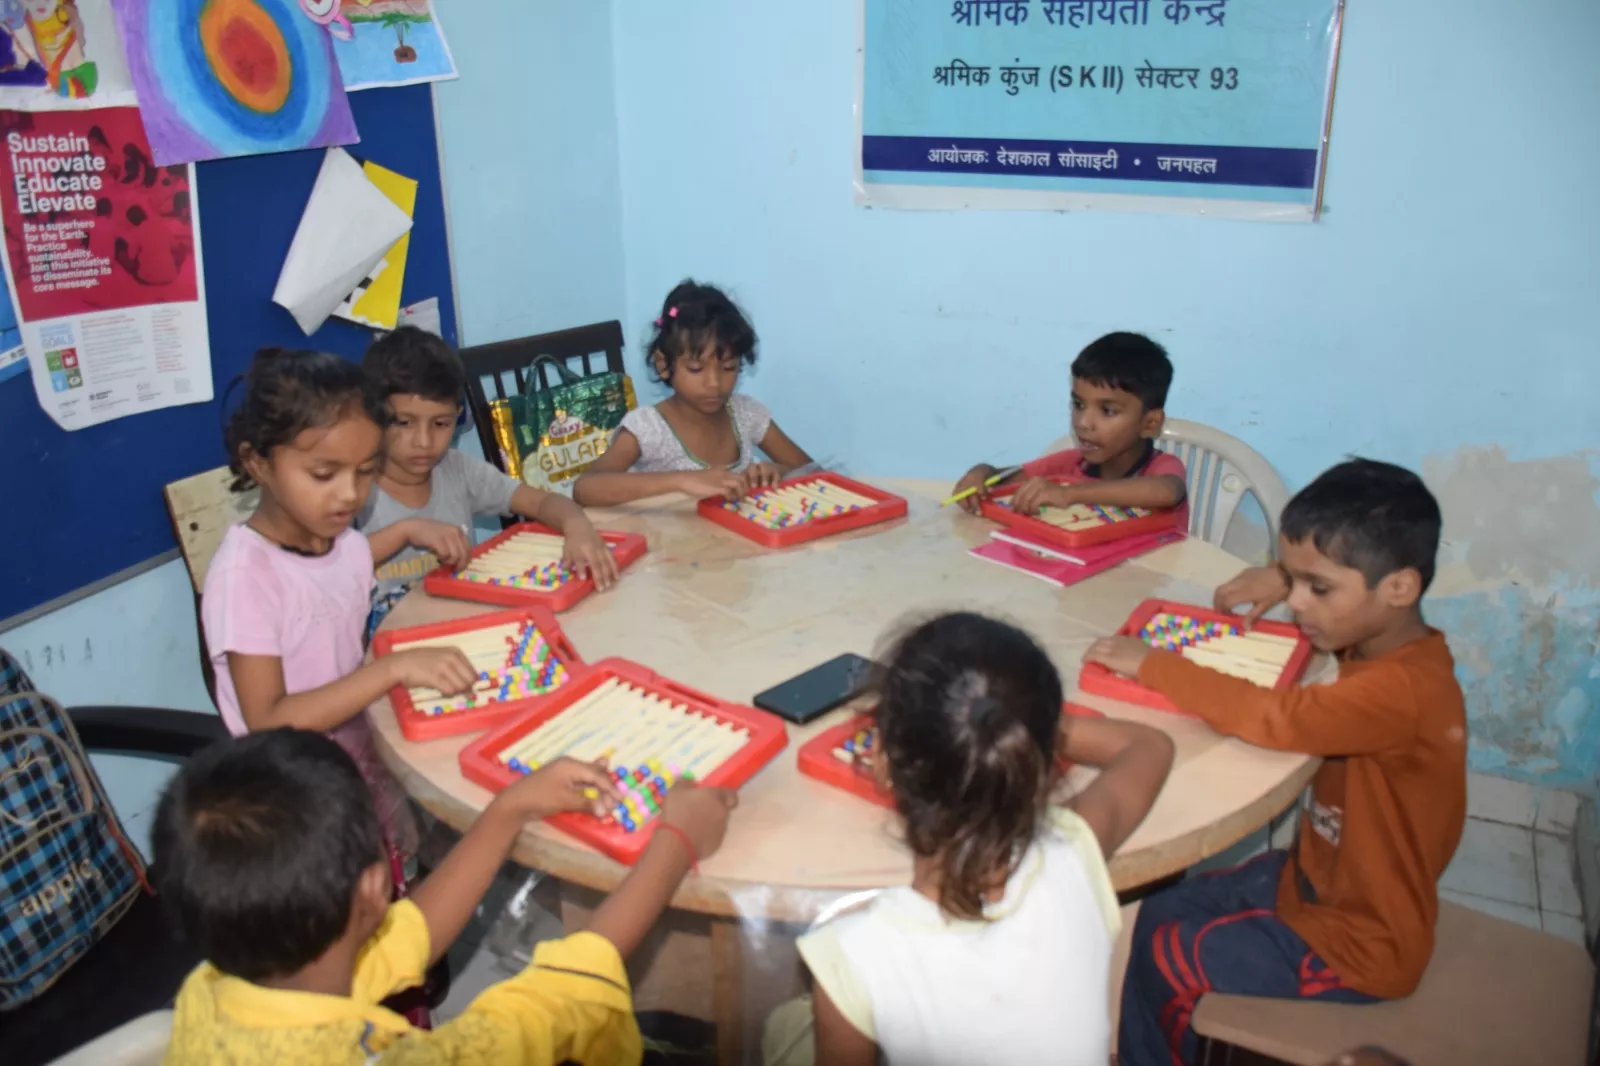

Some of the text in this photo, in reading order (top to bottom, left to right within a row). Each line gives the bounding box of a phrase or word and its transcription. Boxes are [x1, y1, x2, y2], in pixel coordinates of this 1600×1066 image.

[1041, 0, 1150, 28] सहायता
[932, 58, 991, 87] श्रमिक
[999, 57, 1041, 96] कुंज
[1135, 59, 1200, 90] सेक्टर
[1210, 67, 1239, 90] 93
[7, 131, 90, 153] Sustain
[11, 153, 106, 173] Innovate
[997, 146, 1051, 166] देशकाल
[1057, 148, 1119, 171] सोसाइटी
[1156, 156, 1217, 174] जनपहल
[15, 172, 102, 194] Educate
[18, 192, 97, 214] Elevate
[23, 222, 37, 232] Be
[46, 219, 95, 232] superhero
[25, 229, 88, 242] for the Earth.
[26, 241, 67, 252] Practice
[28, 248, 94, 263] sustainability.
[31, 256, 111, 273] Join this initiative
[31, 266, 112, 282] to disseminate its
[33, 278, 99, 293] core message.
[20, 858, 92, 916] apple
